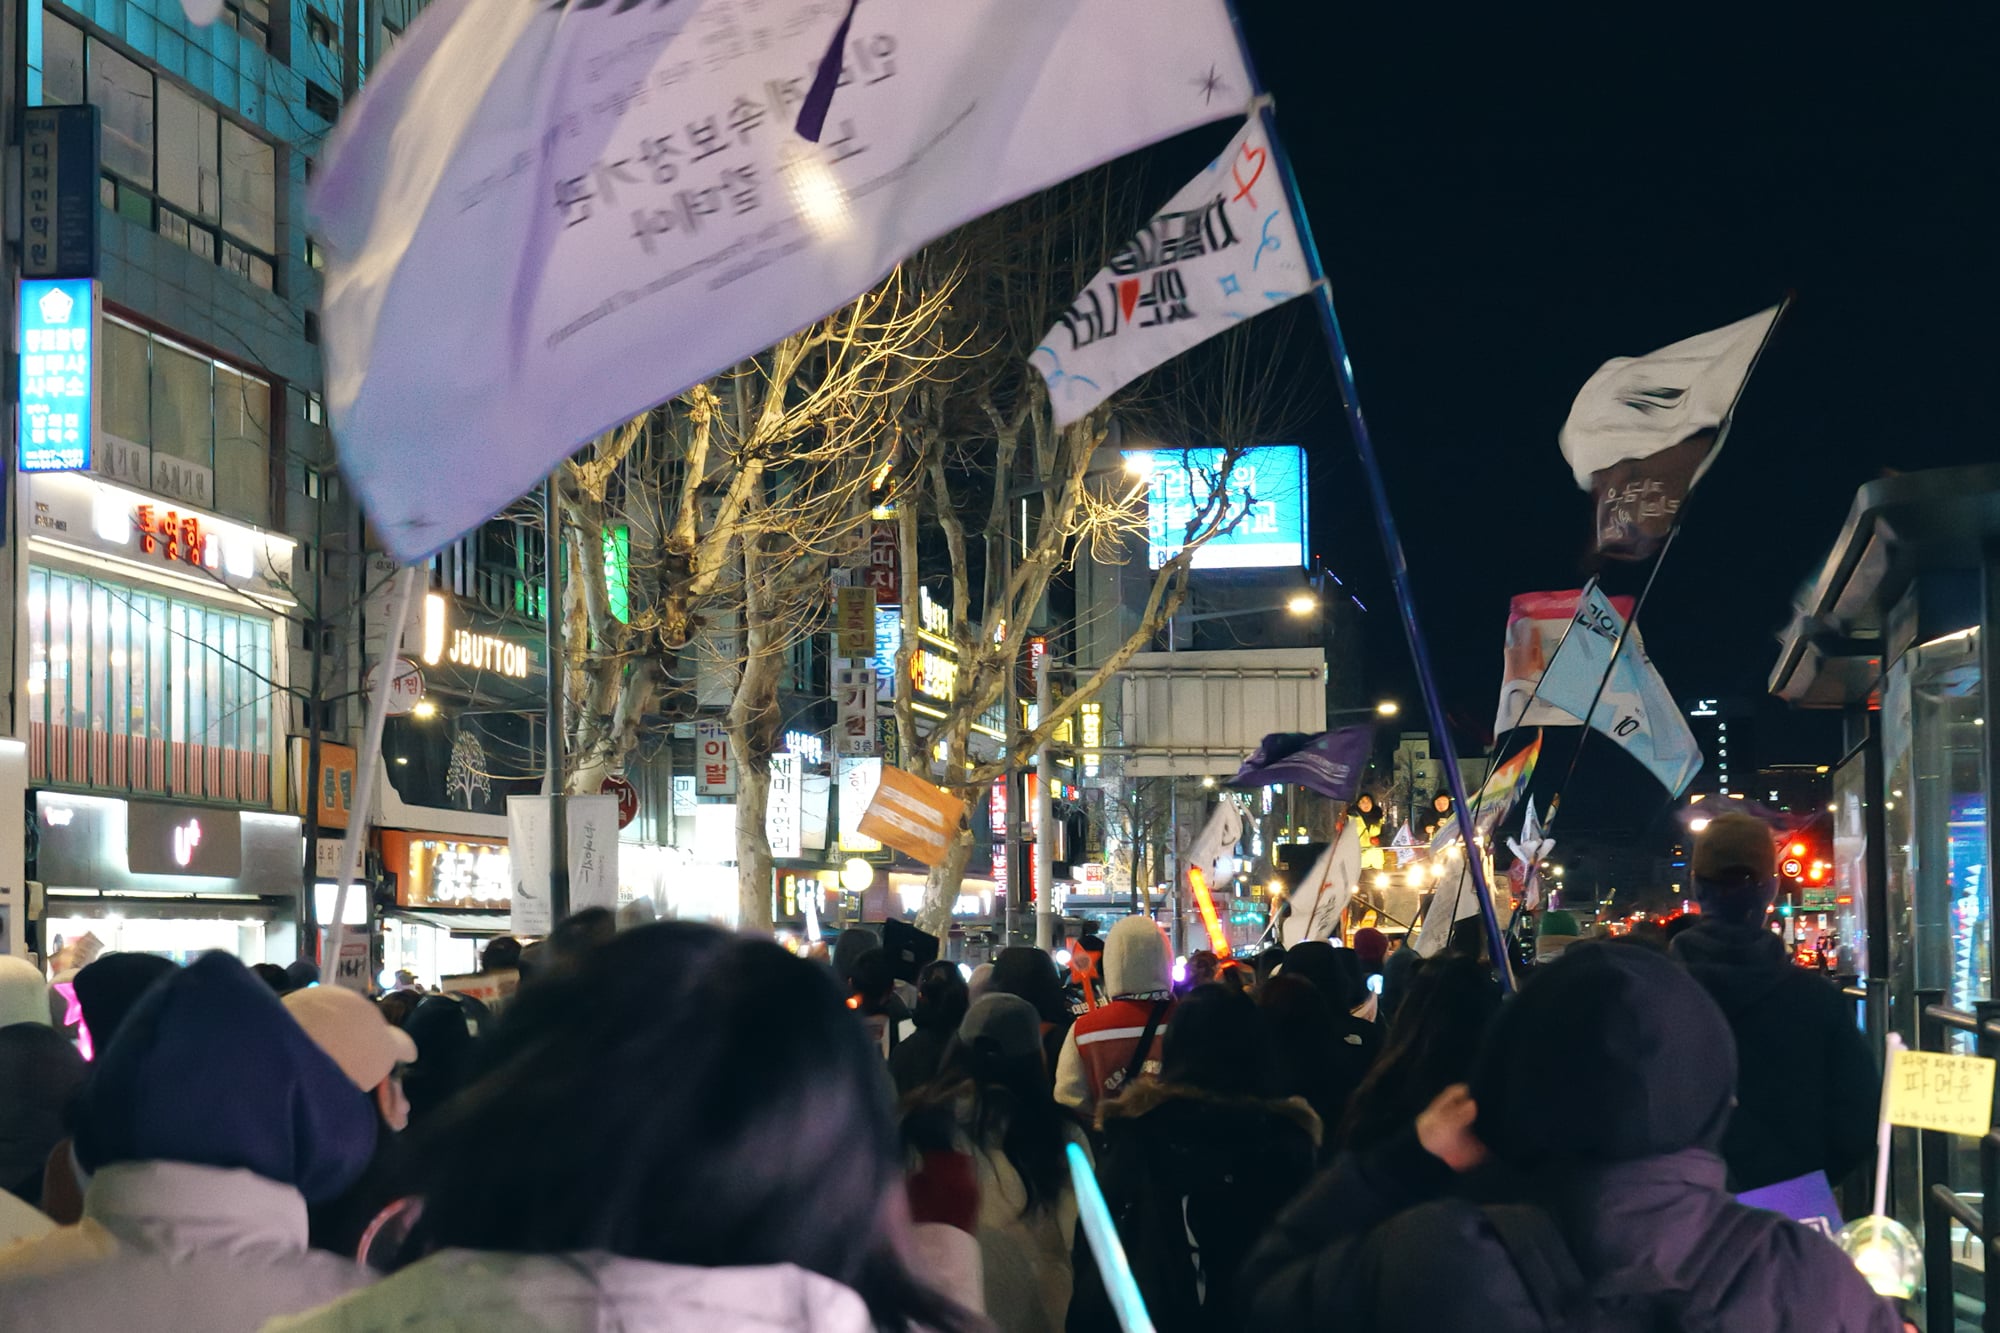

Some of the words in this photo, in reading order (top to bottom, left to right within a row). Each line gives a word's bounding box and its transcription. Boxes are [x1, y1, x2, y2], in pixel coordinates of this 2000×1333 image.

[449, 629, 528, 679] JBUTTON
[1614, 716, 1640, 737] 10
[704, 741, 730, 785] 이발
[1786, 863, 1798, 873] 50
